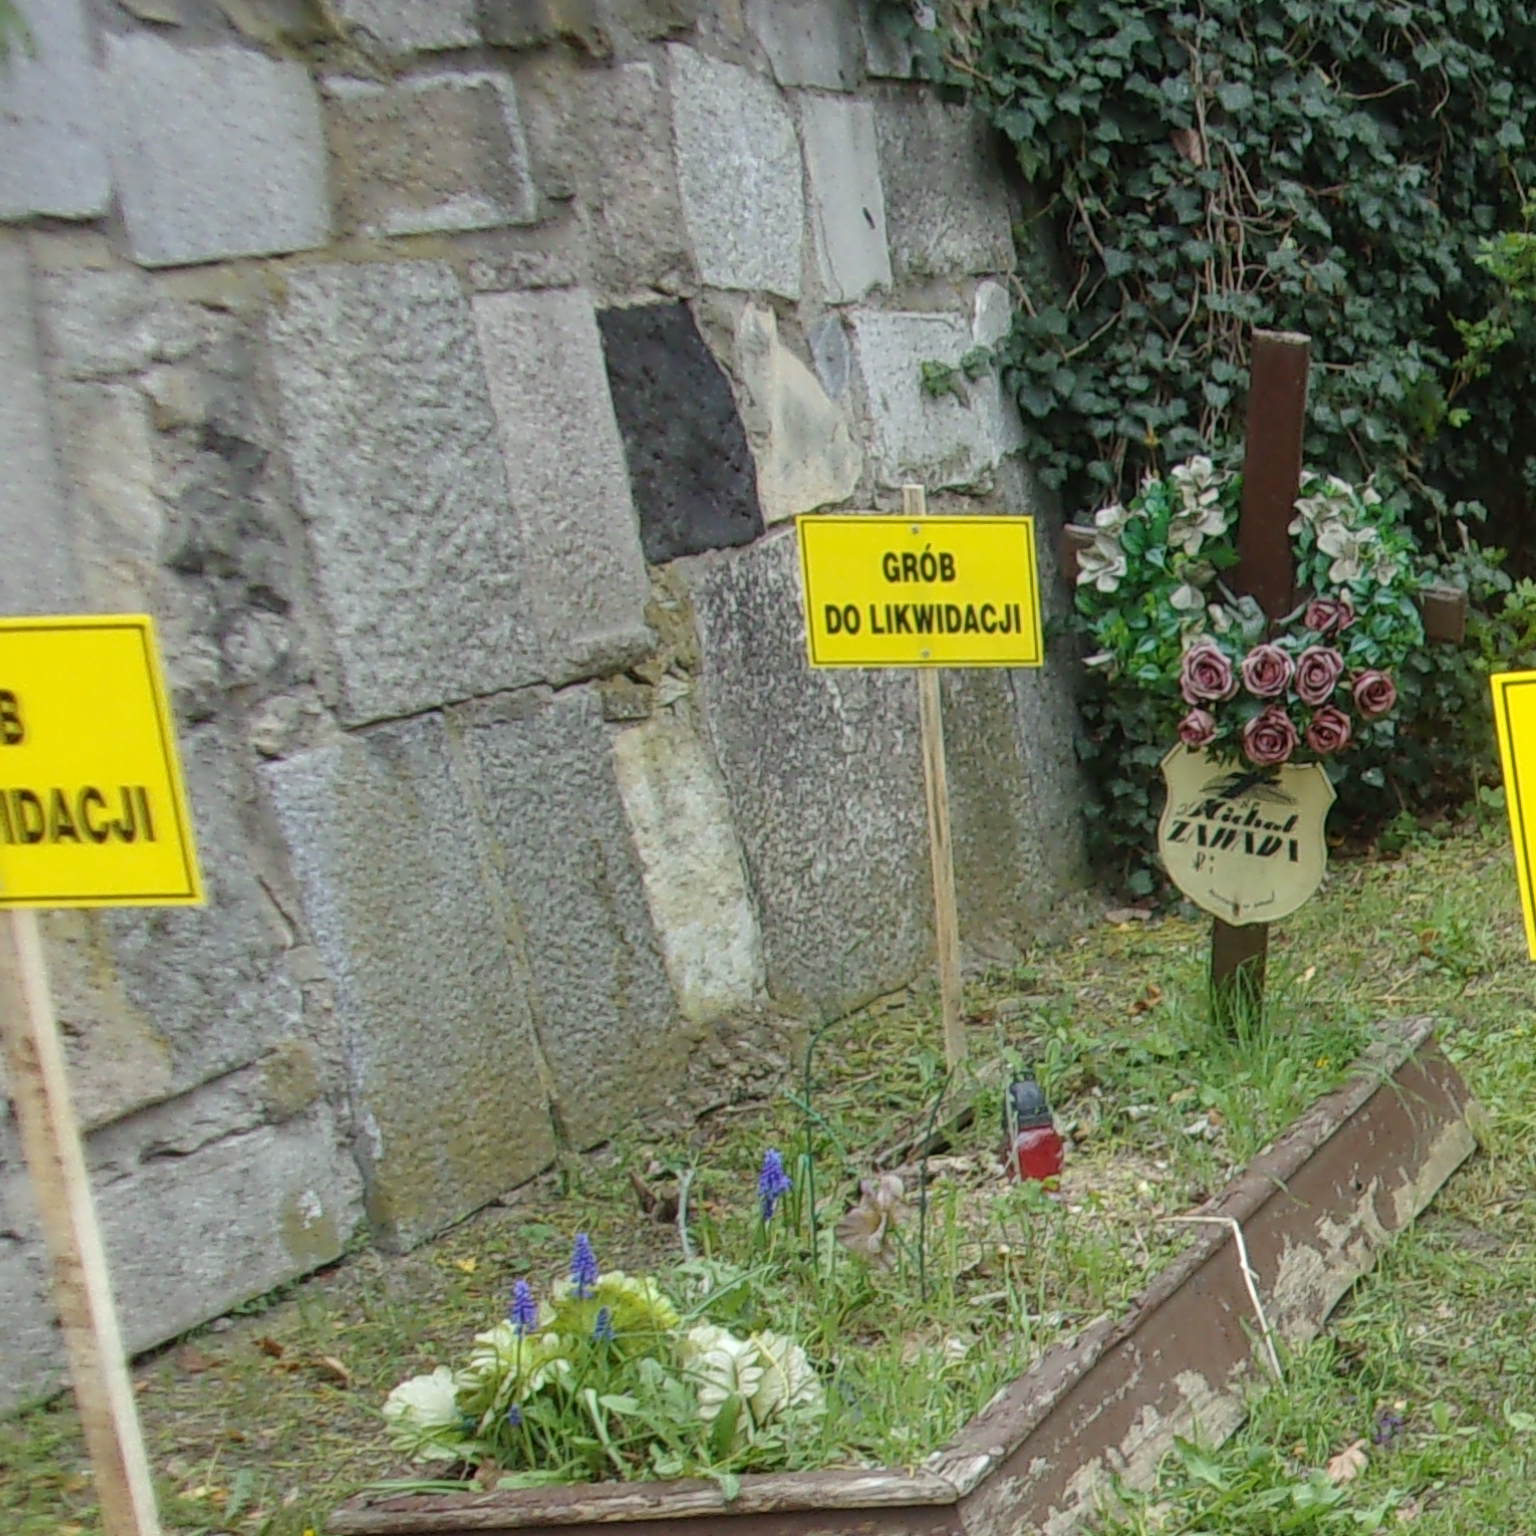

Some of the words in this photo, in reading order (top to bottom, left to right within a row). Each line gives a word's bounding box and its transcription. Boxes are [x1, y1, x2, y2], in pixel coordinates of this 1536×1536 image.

[882, 543, 957, 584] GRÓB
[824, 605, 861, 635] DO
[869, 603, 1022, 635] LIKWIDACJI
[0, 786, 156, 845] IDACJI
